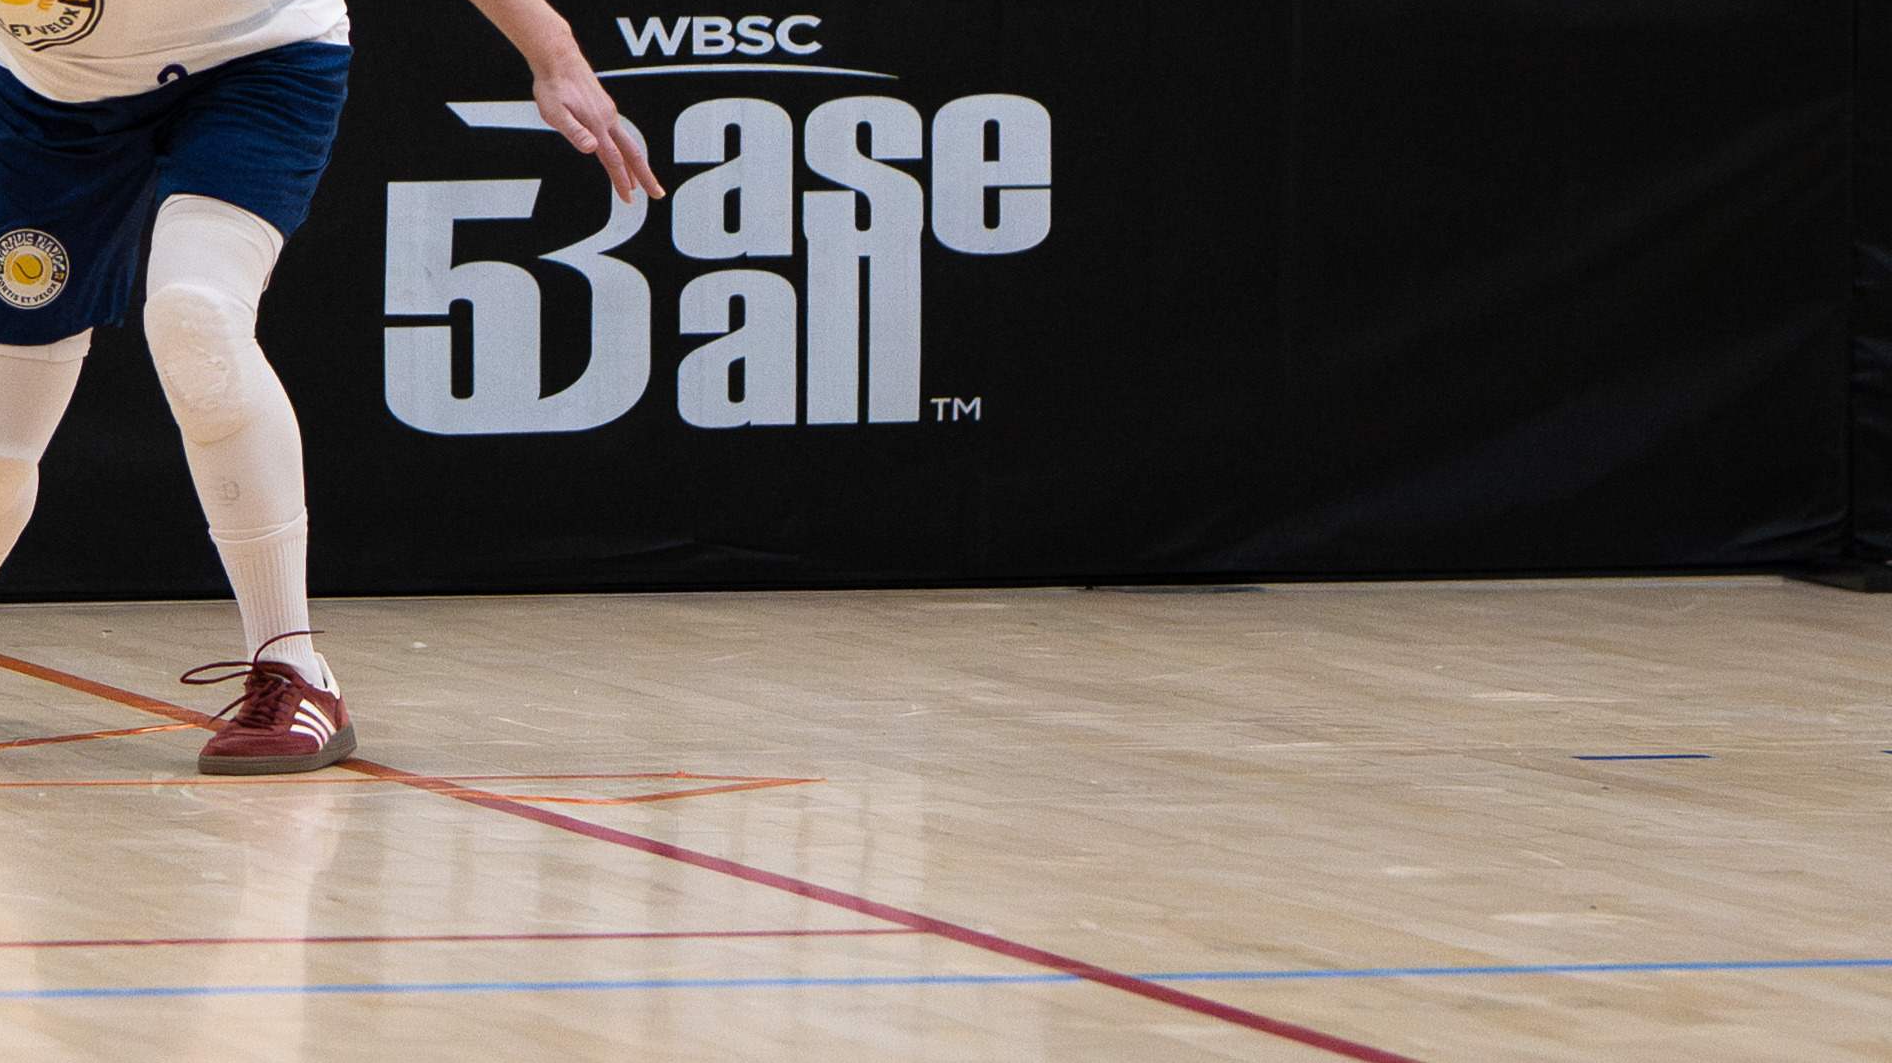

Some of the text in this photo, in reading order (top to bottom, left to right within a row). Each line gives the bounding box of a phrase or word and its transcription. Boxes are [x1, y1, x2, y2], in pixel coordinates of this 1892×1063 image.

[36, 8, 81, 36] VELOX
[616, 15, 823, 57] WBSC
[21, 296, 31, 304] ET
[33, 282, 58, 303] VELOX
[931, 397, 982, 422] TM
